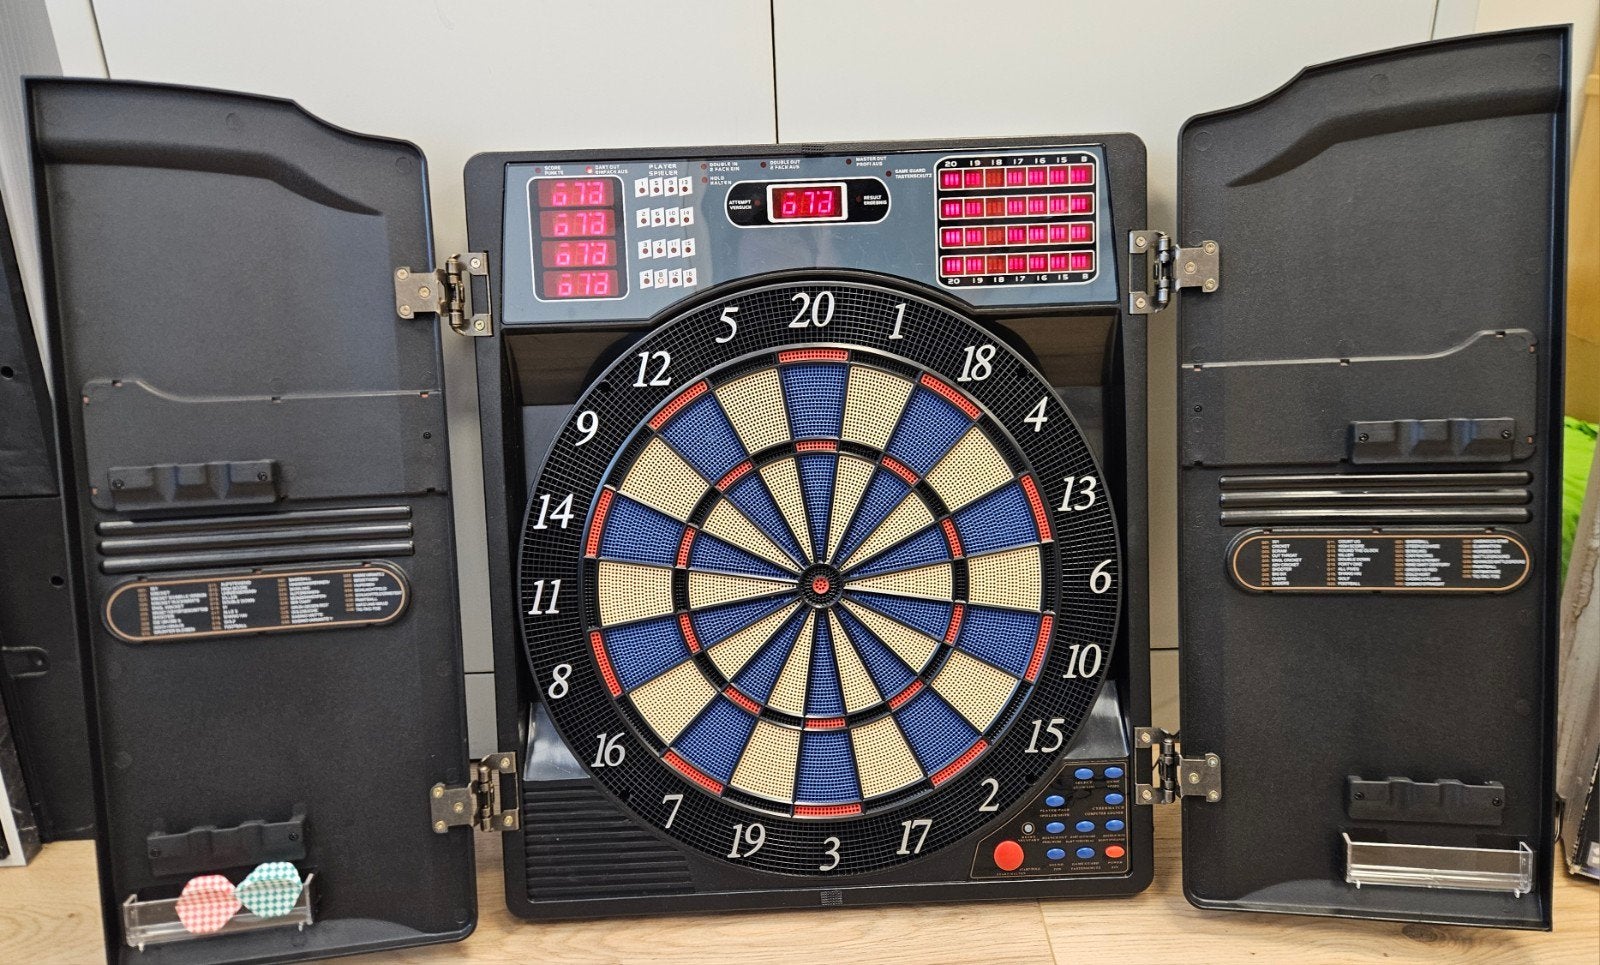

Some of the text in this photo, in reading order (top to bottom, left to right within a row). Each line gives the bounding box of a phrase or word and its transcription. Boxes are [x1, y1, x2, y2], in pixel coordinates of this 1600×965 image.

[716, 307, 739, 344] 5
[788, 291, 834, 328] 20
[888, 303, 906, 340] 1
[632, 351, 672, 388] 12
[957, 344, 996, 382] 18
[574, 410, 598, 446] 9
[1024, 396, 1048, 432] 4
[532, 494, 574, 530] 14
[1057, 476, 1096, 512] 13
[1089, 559, 1112, 594] 6
[528, 579, 562, 615] 11
[1062, 644, 1102, 679] 10
[548, 664, 572, 699] 8
[590, 732, 626, 768] 16
[1024, 718, 1066, 754] 15
[662, 794, 684, 830] 7
[978, 778, 1000, 812] 2
[726, 822, 766, 859] 19
[819, 836, 841, 872] 3
[896, 819, 933, 855] 17
